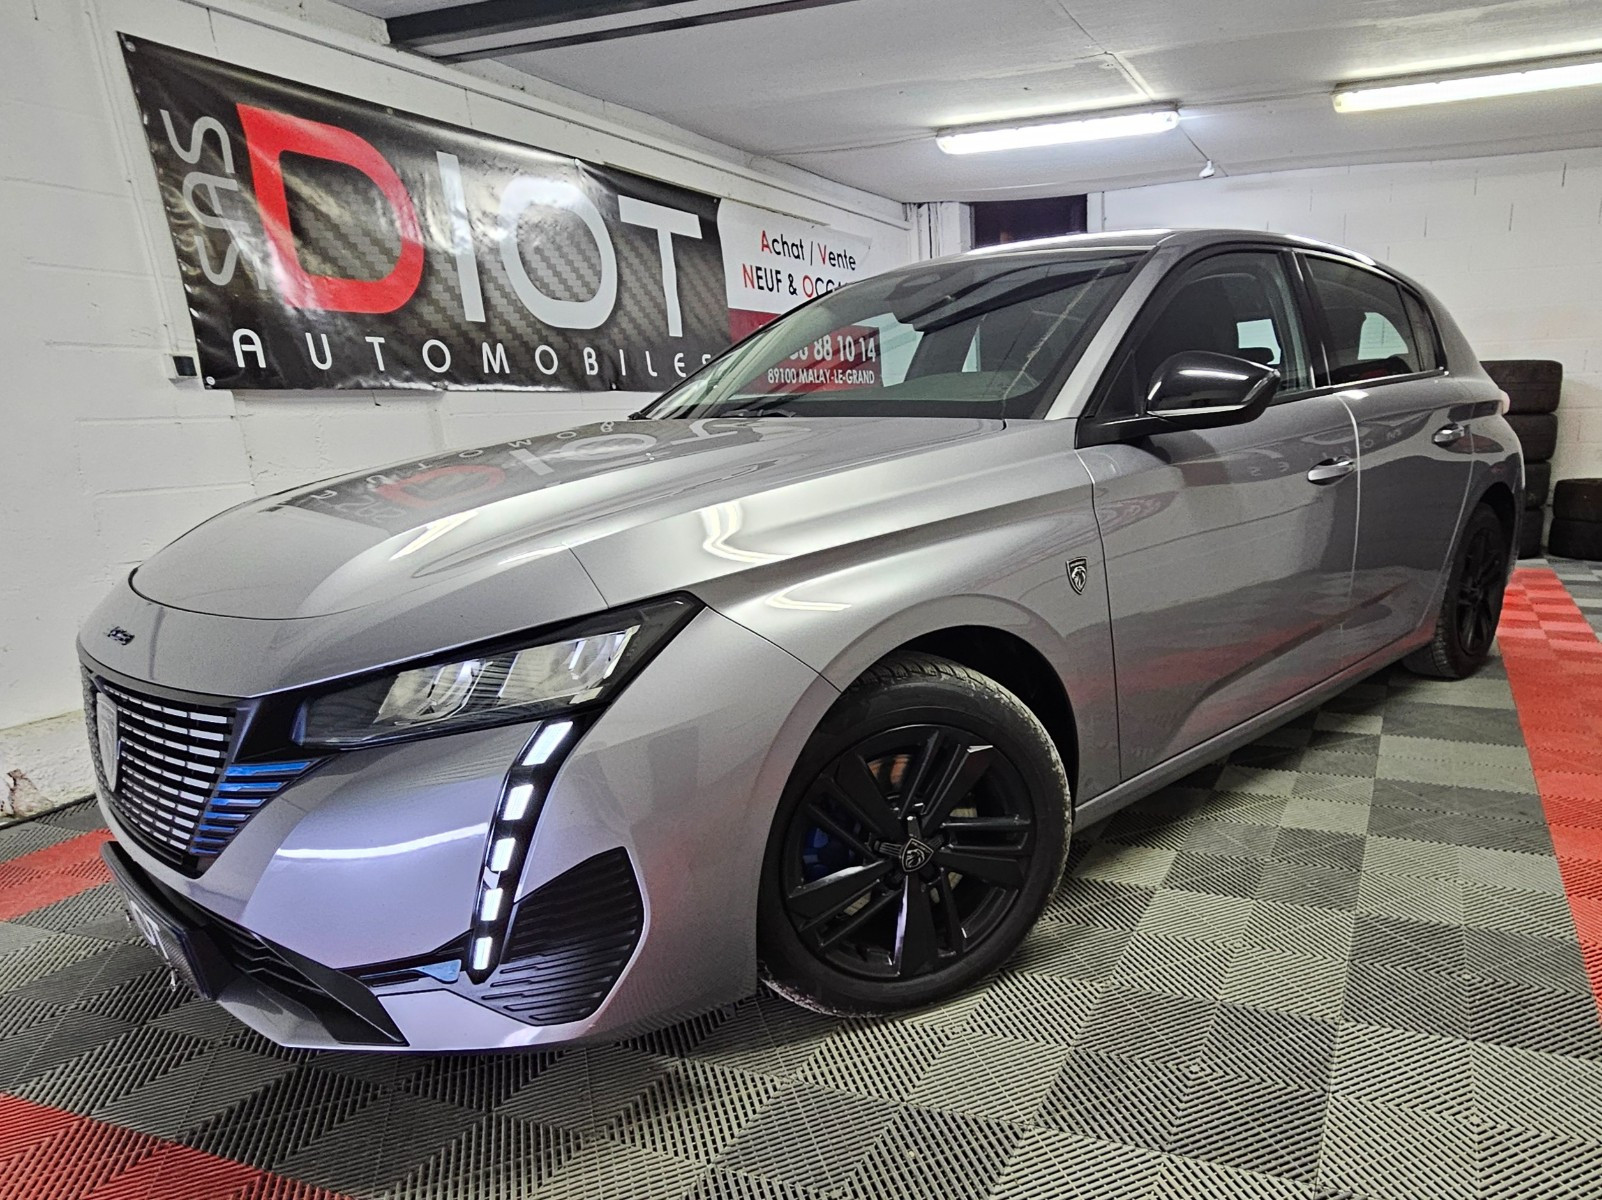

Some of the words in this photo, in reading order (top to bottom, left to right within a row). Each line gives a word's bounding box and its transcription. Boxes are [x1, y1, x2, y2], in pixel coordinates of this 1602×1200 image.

[159, 109, 268, 291] SAS
[236, 102, 703, 338] DIOT
[761, 229, 805, 261] Achat
[809, 240, 814, 266] /
[817, 242, 857, 271] Vente
[742, 263, 782, 294] NEUF
[787, 273, 798, 297] &
[837, 335, 856, 362] 10
[859, 337, 876, 362] 14
[767, 367, 797, 384] 89100
[798, 368, 875, 384] MALAY-LE-GRAND
